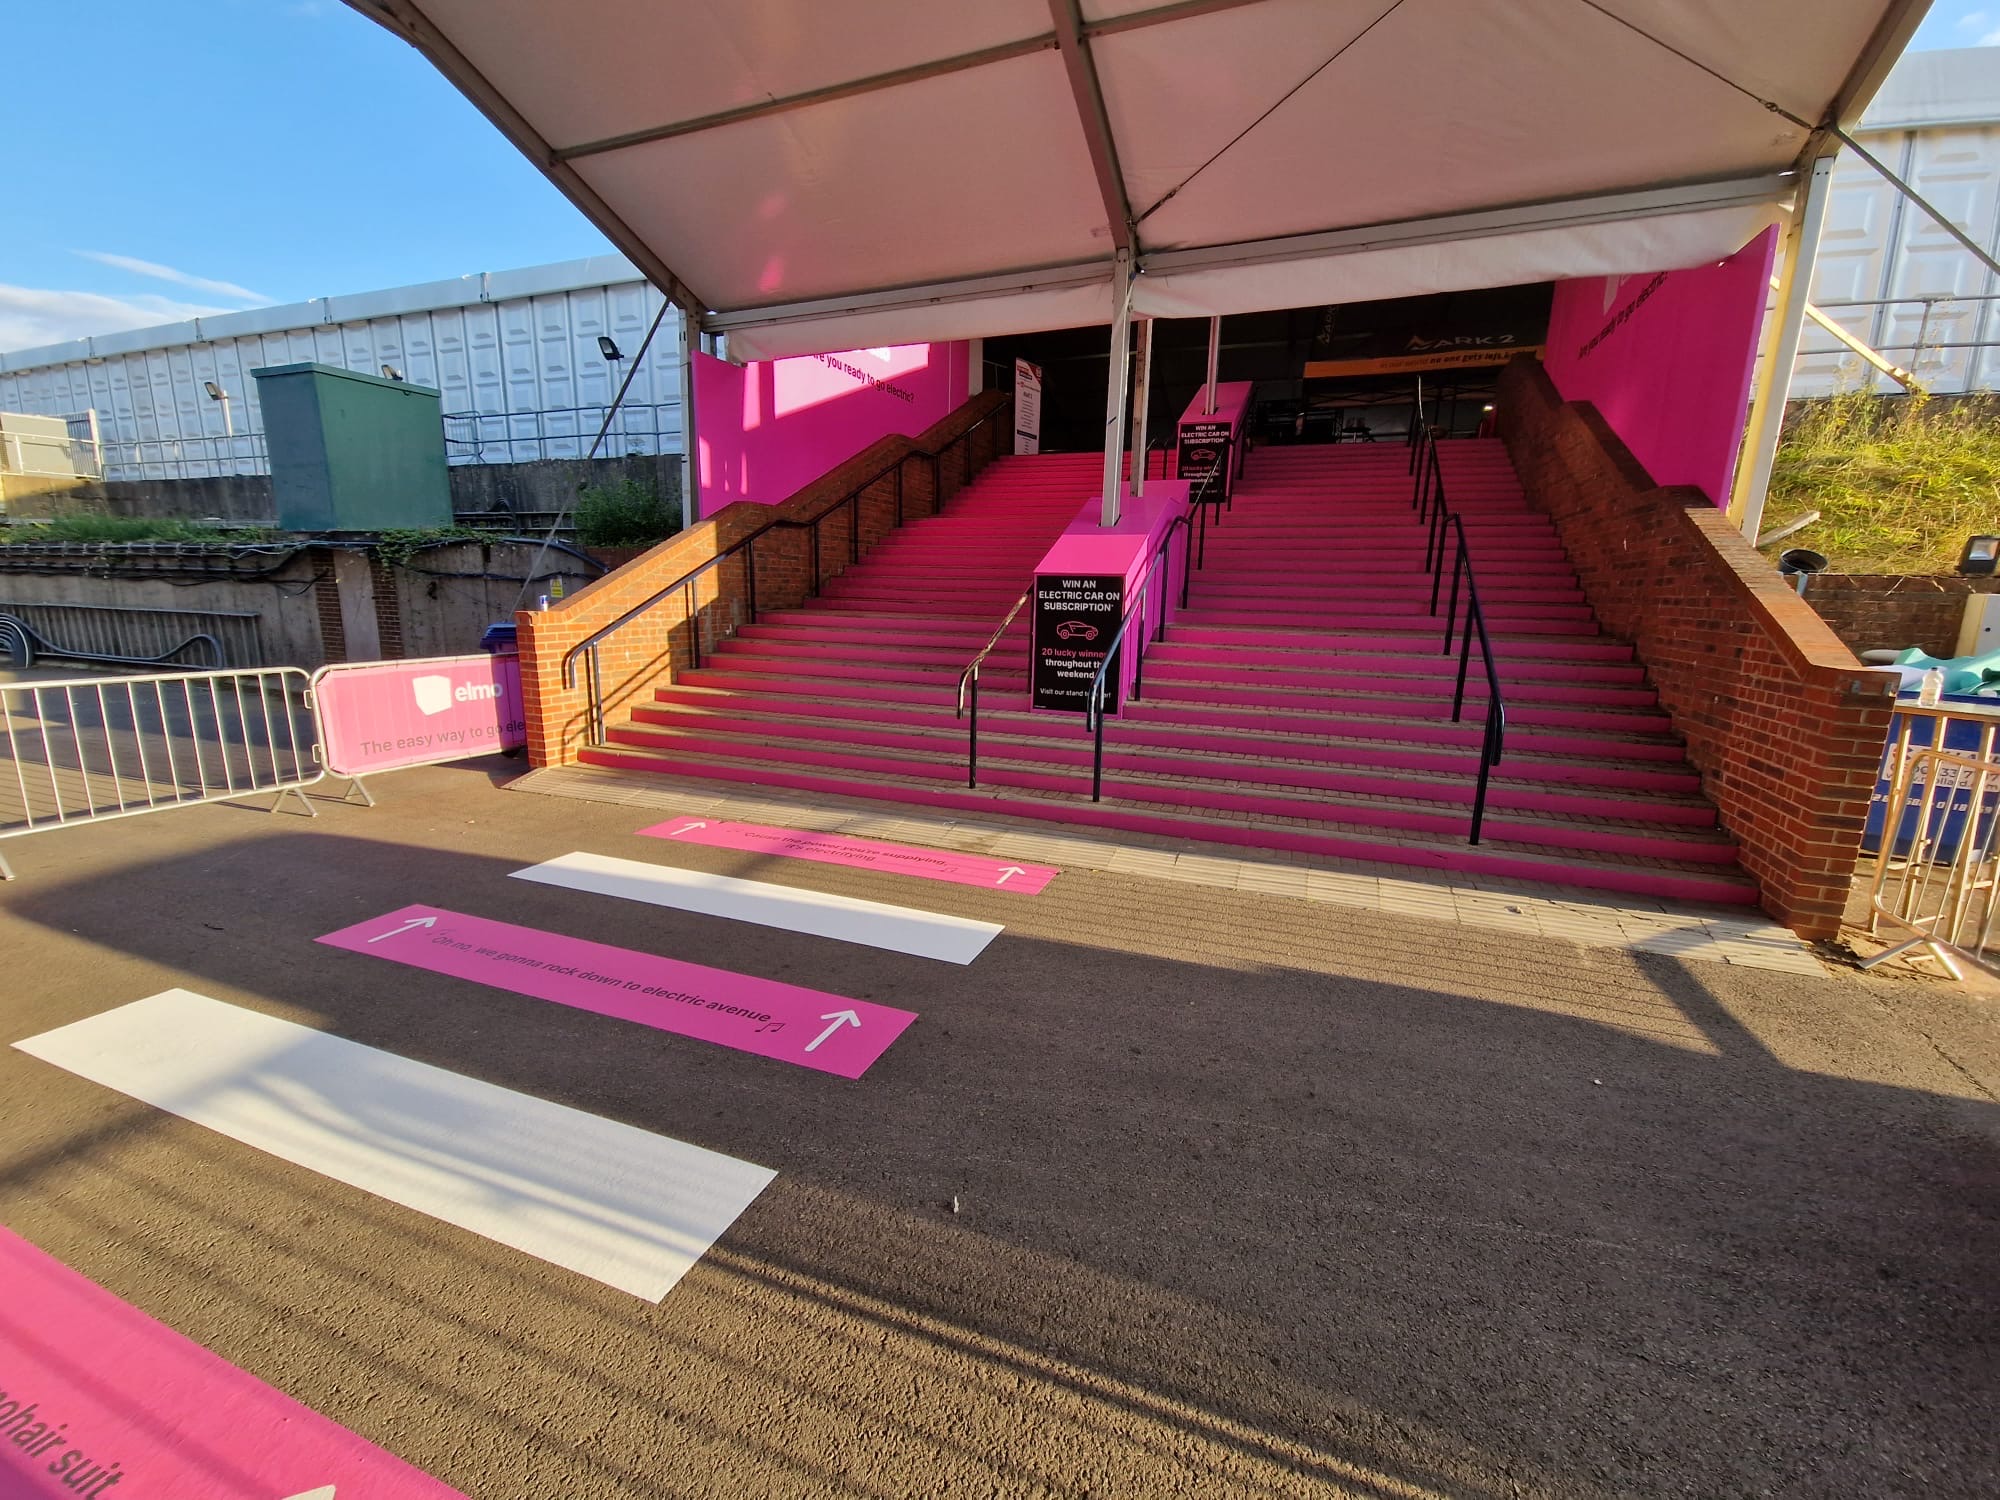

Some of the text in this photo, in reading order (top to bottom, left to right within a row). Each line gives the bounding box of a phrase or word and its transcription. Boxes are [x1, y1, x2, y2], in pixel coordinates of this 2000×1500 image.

[826, 355, 842, 369] you
[844, 363, 866, 384] ready
[867, 372, 875, 385] to
[876, 379, 886, 391] go
[886, 383, 914, 402] electric?
[1062, 580, 1097, 588] WIN AN
[1039, 590, 1120, 600] ELECTRIC CAR ON
[1041, 648, 1053, 656] 20
[1054, 649, 1077, 658] lucky
[1045, 659, 1102, 669] throughout th
[1057, 670, 1095, 679] weekend
[455, 682, 503, 702] elmo
[360, 738, 393, 756] The
[397, 734, 433, 750] easy
[436, 729, 466, 744] way
[470, 726, 483, 738] to
[486, 725, 503, 738] go
[432, 936, 454, 946] Oh
[475, 947, 498, 957] we
[492, 952, 544, 968] gonna
[542, 962, 581, 976] rock
[577, 970, 623, 987] down
[622, 980, 642, 991] to
[641, 984, 707, 1007] electric
[706, 1001, 772, 1023] avenue
[48, 1449, 125, 1500] suit
